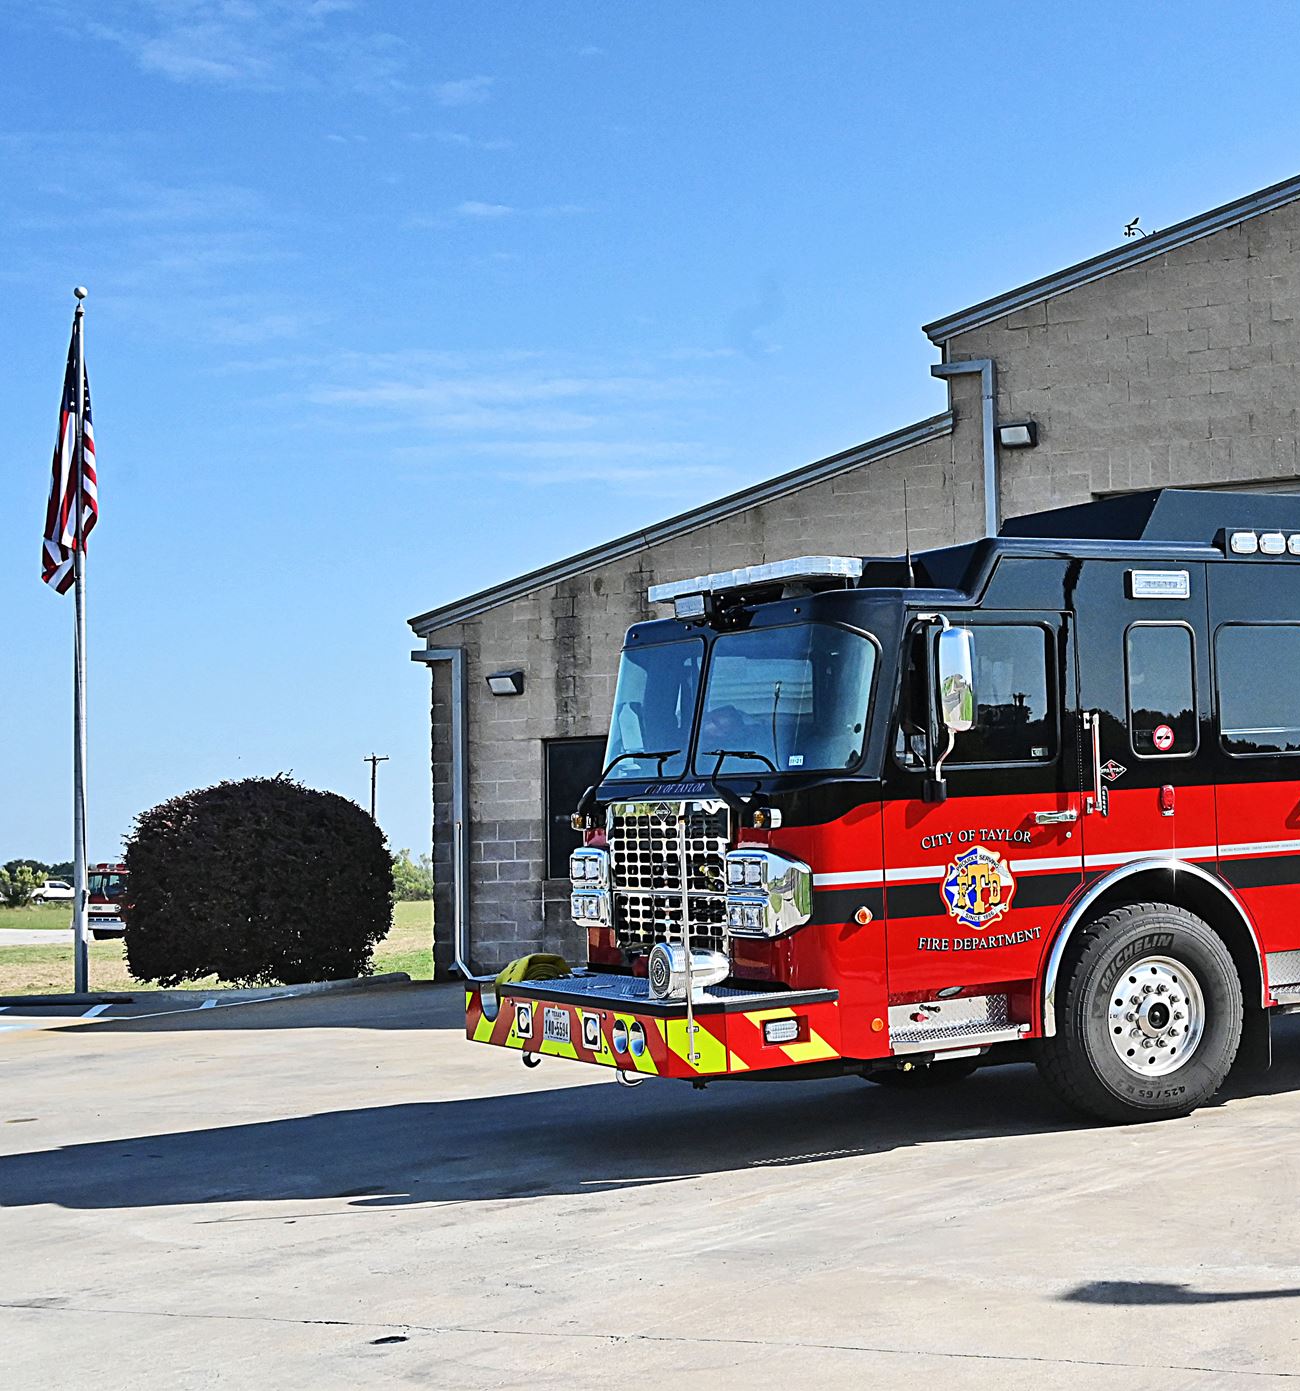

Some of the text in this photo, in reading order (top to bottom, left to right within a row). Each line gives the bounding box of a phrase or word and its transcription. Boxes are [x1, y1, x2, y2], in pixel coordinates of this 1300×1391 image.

[662, 784, 676, 793] OF
[674, 783, 705, 793] TAYLOR
[921, 829, 1031, 849] CITY OF TAYLOR
[956, 854, 1000, 872] PROUDLY SERVING
[965, 912, 981, 921] SINCE
[918, 926, 1042, 951] FIRE DEPARTMENT
[1101, 934, 1173, 991] MICHELIN
[551, 1010, 562, 1018] TEXAS
